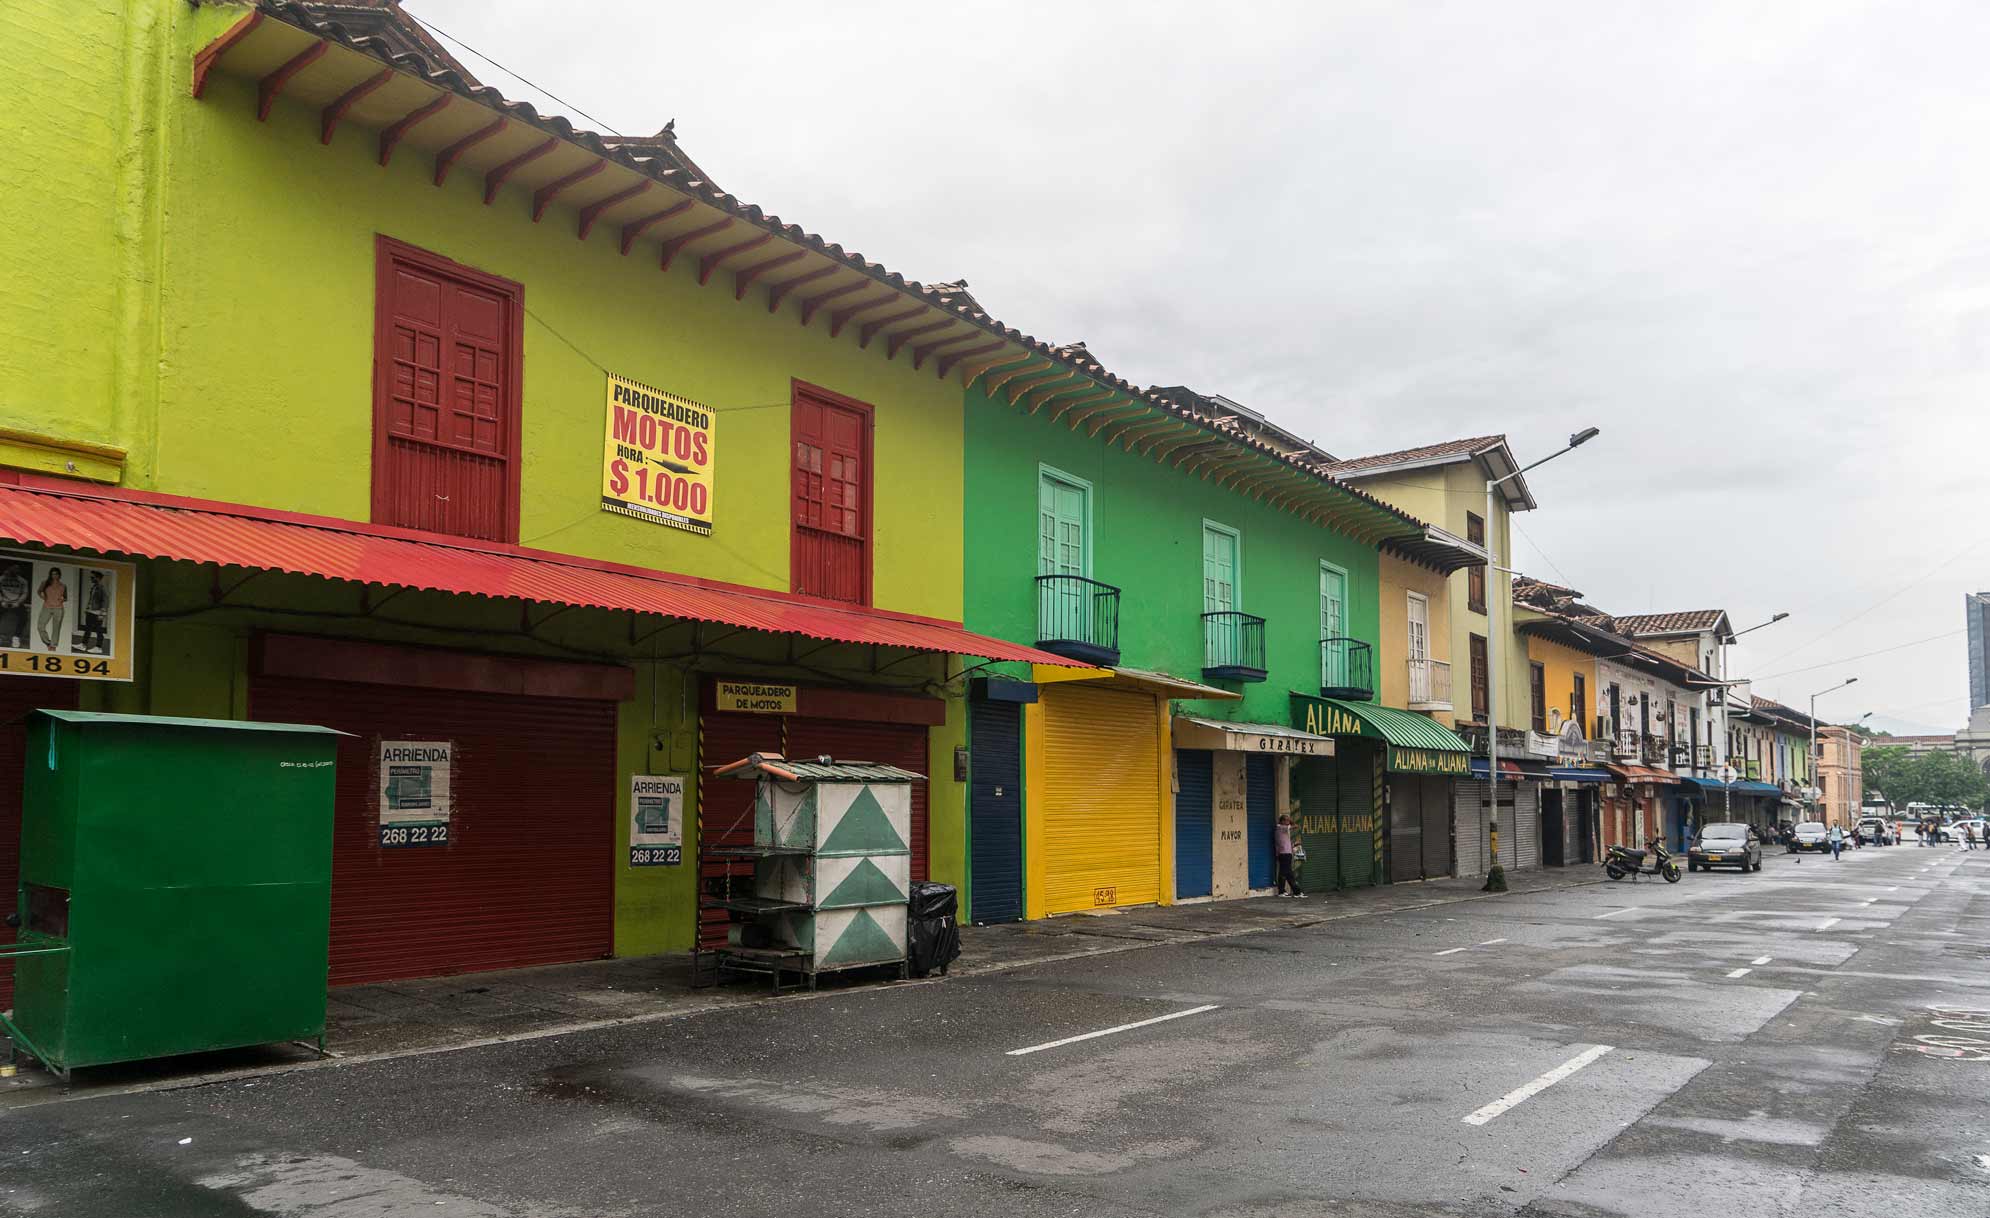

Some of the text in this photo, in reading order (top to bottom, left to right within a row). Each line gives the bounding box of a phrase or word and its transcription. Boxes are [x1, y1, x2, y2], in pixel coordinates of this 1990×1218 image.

[614, 384, 708, 430] PARQUEADERO
[612, 405, 708, 466] MOTOS
[26, 655, 62, 672] 18
[74, 659, 110, 675] 94
[723, 685, 791, 697] PARQUEADERO
[736, 699, 782, 710] DE MOTOS
[1306, 703, 1361, 735] ALIANA
[1259, 738, 1315, 753] GIRATEX
[383, 748, 448, 762] ARRIENDA
[1394, 750, 1428, 772] ALIANA
[1438, 752, 1468, 773] ALIANA
[633, 781, 682, 794] ARRIENDA
[1302, 815, 1374, 833] ALIANA ALIANA
[382, 827, 447, 844] 268 22 22
[1221, 831, 1242, 841] MAYOR
[632, 849, 680, 862] 268 22 22
